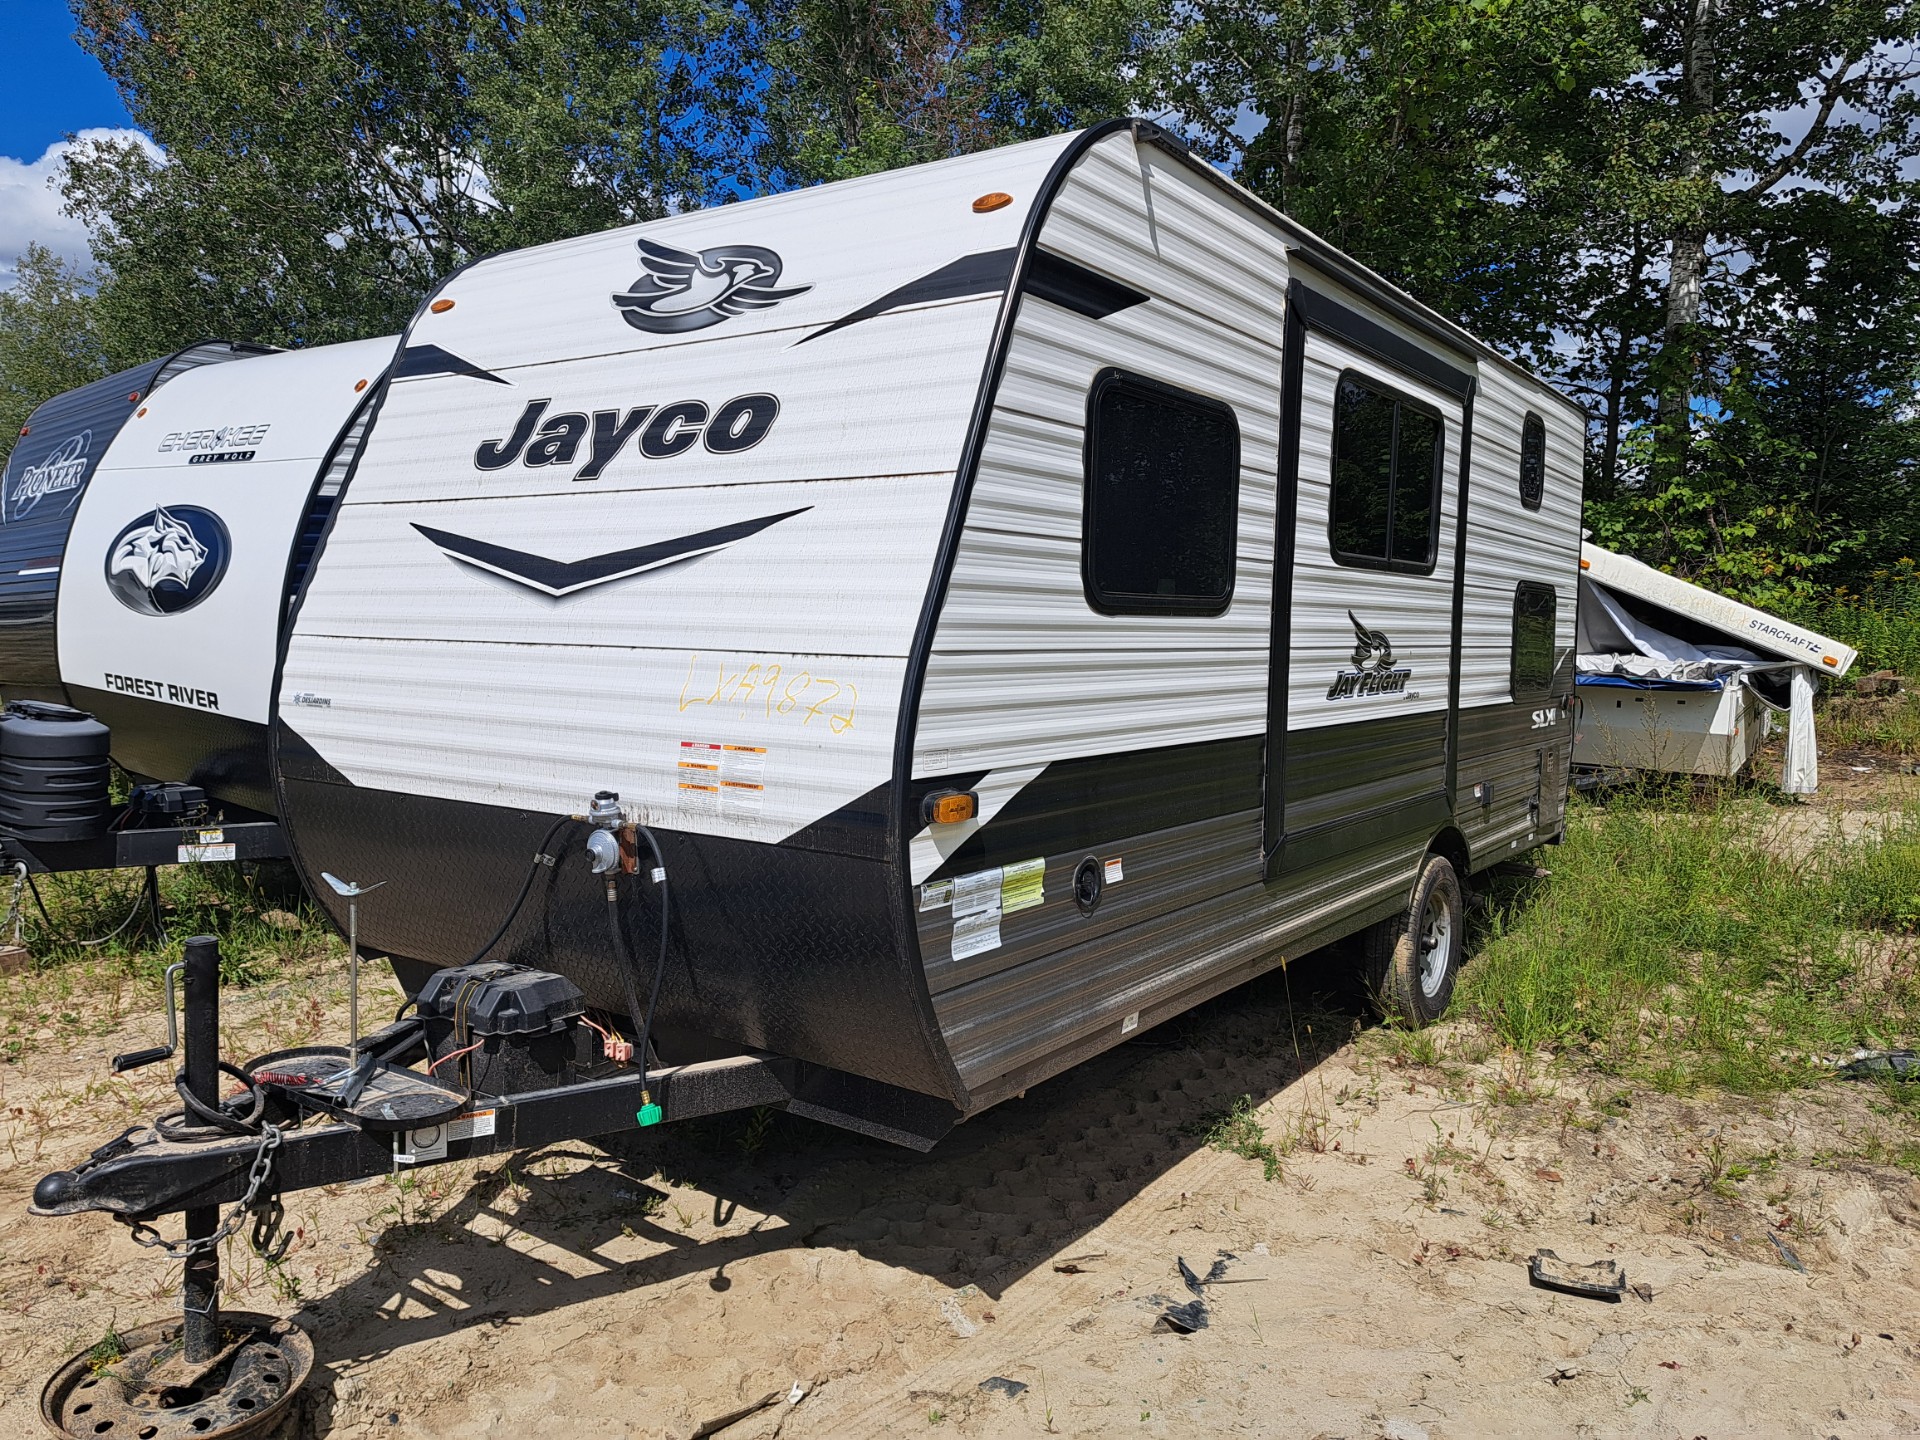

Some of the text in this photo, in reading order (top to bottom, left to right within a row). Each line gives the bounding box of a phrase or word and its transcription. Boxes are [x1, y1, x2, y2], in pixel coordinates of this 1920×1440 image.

[474, 392, 780, 482] Jayco
[192, 452, 252, 463] GREY WOLF
[1749, 619, 1812, 651] STARCRAFT
[104, 672, 219, 710] FOREST RIVER
[1326, 669, 1411, 700] JAY FLIGHT
